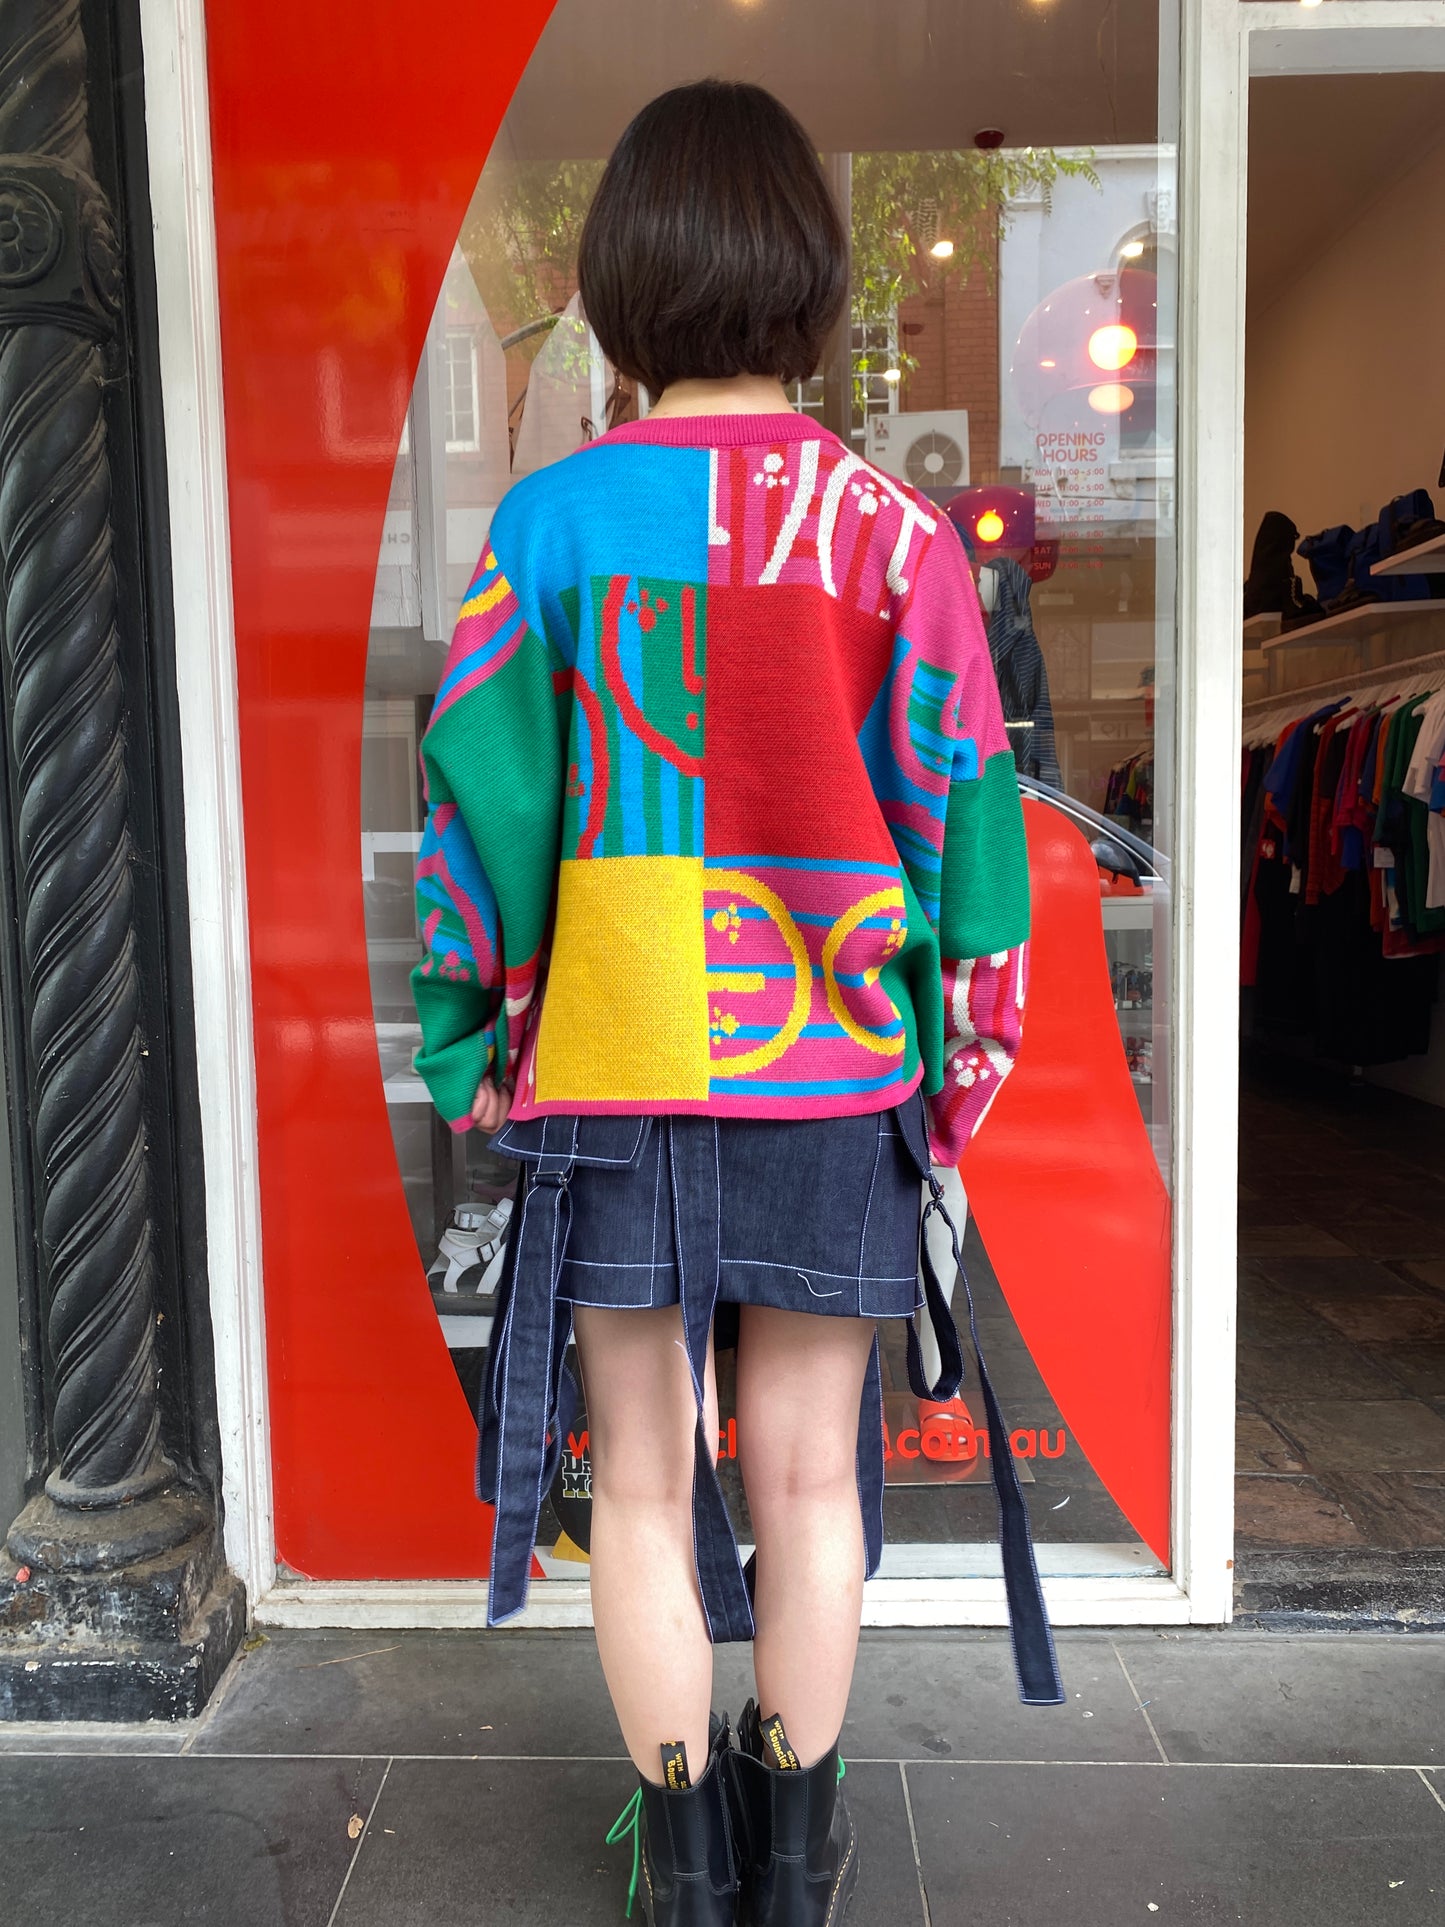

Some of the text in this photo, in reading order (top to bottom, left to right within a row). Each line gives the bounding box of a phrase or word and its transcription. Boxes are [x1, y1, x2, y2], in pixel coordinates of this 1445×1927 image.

[1035, 432, 1106, 447] OPENING
[1043, 448, 1098, 463] HOURS
[1034, 468, 1052, 477] MON
[1058, 468, 1080, 476] 11:00
[1058, 484, 1080, 492] 11:00
[1086, 483, 1105, 492] 5:00
[1086, 499, 1105, 507] 5:00
[1033, 546, 1051, 554] SAT
[774, 1720, 785, 1740] WITH
[675, 1752, 685, 1772] WITH
